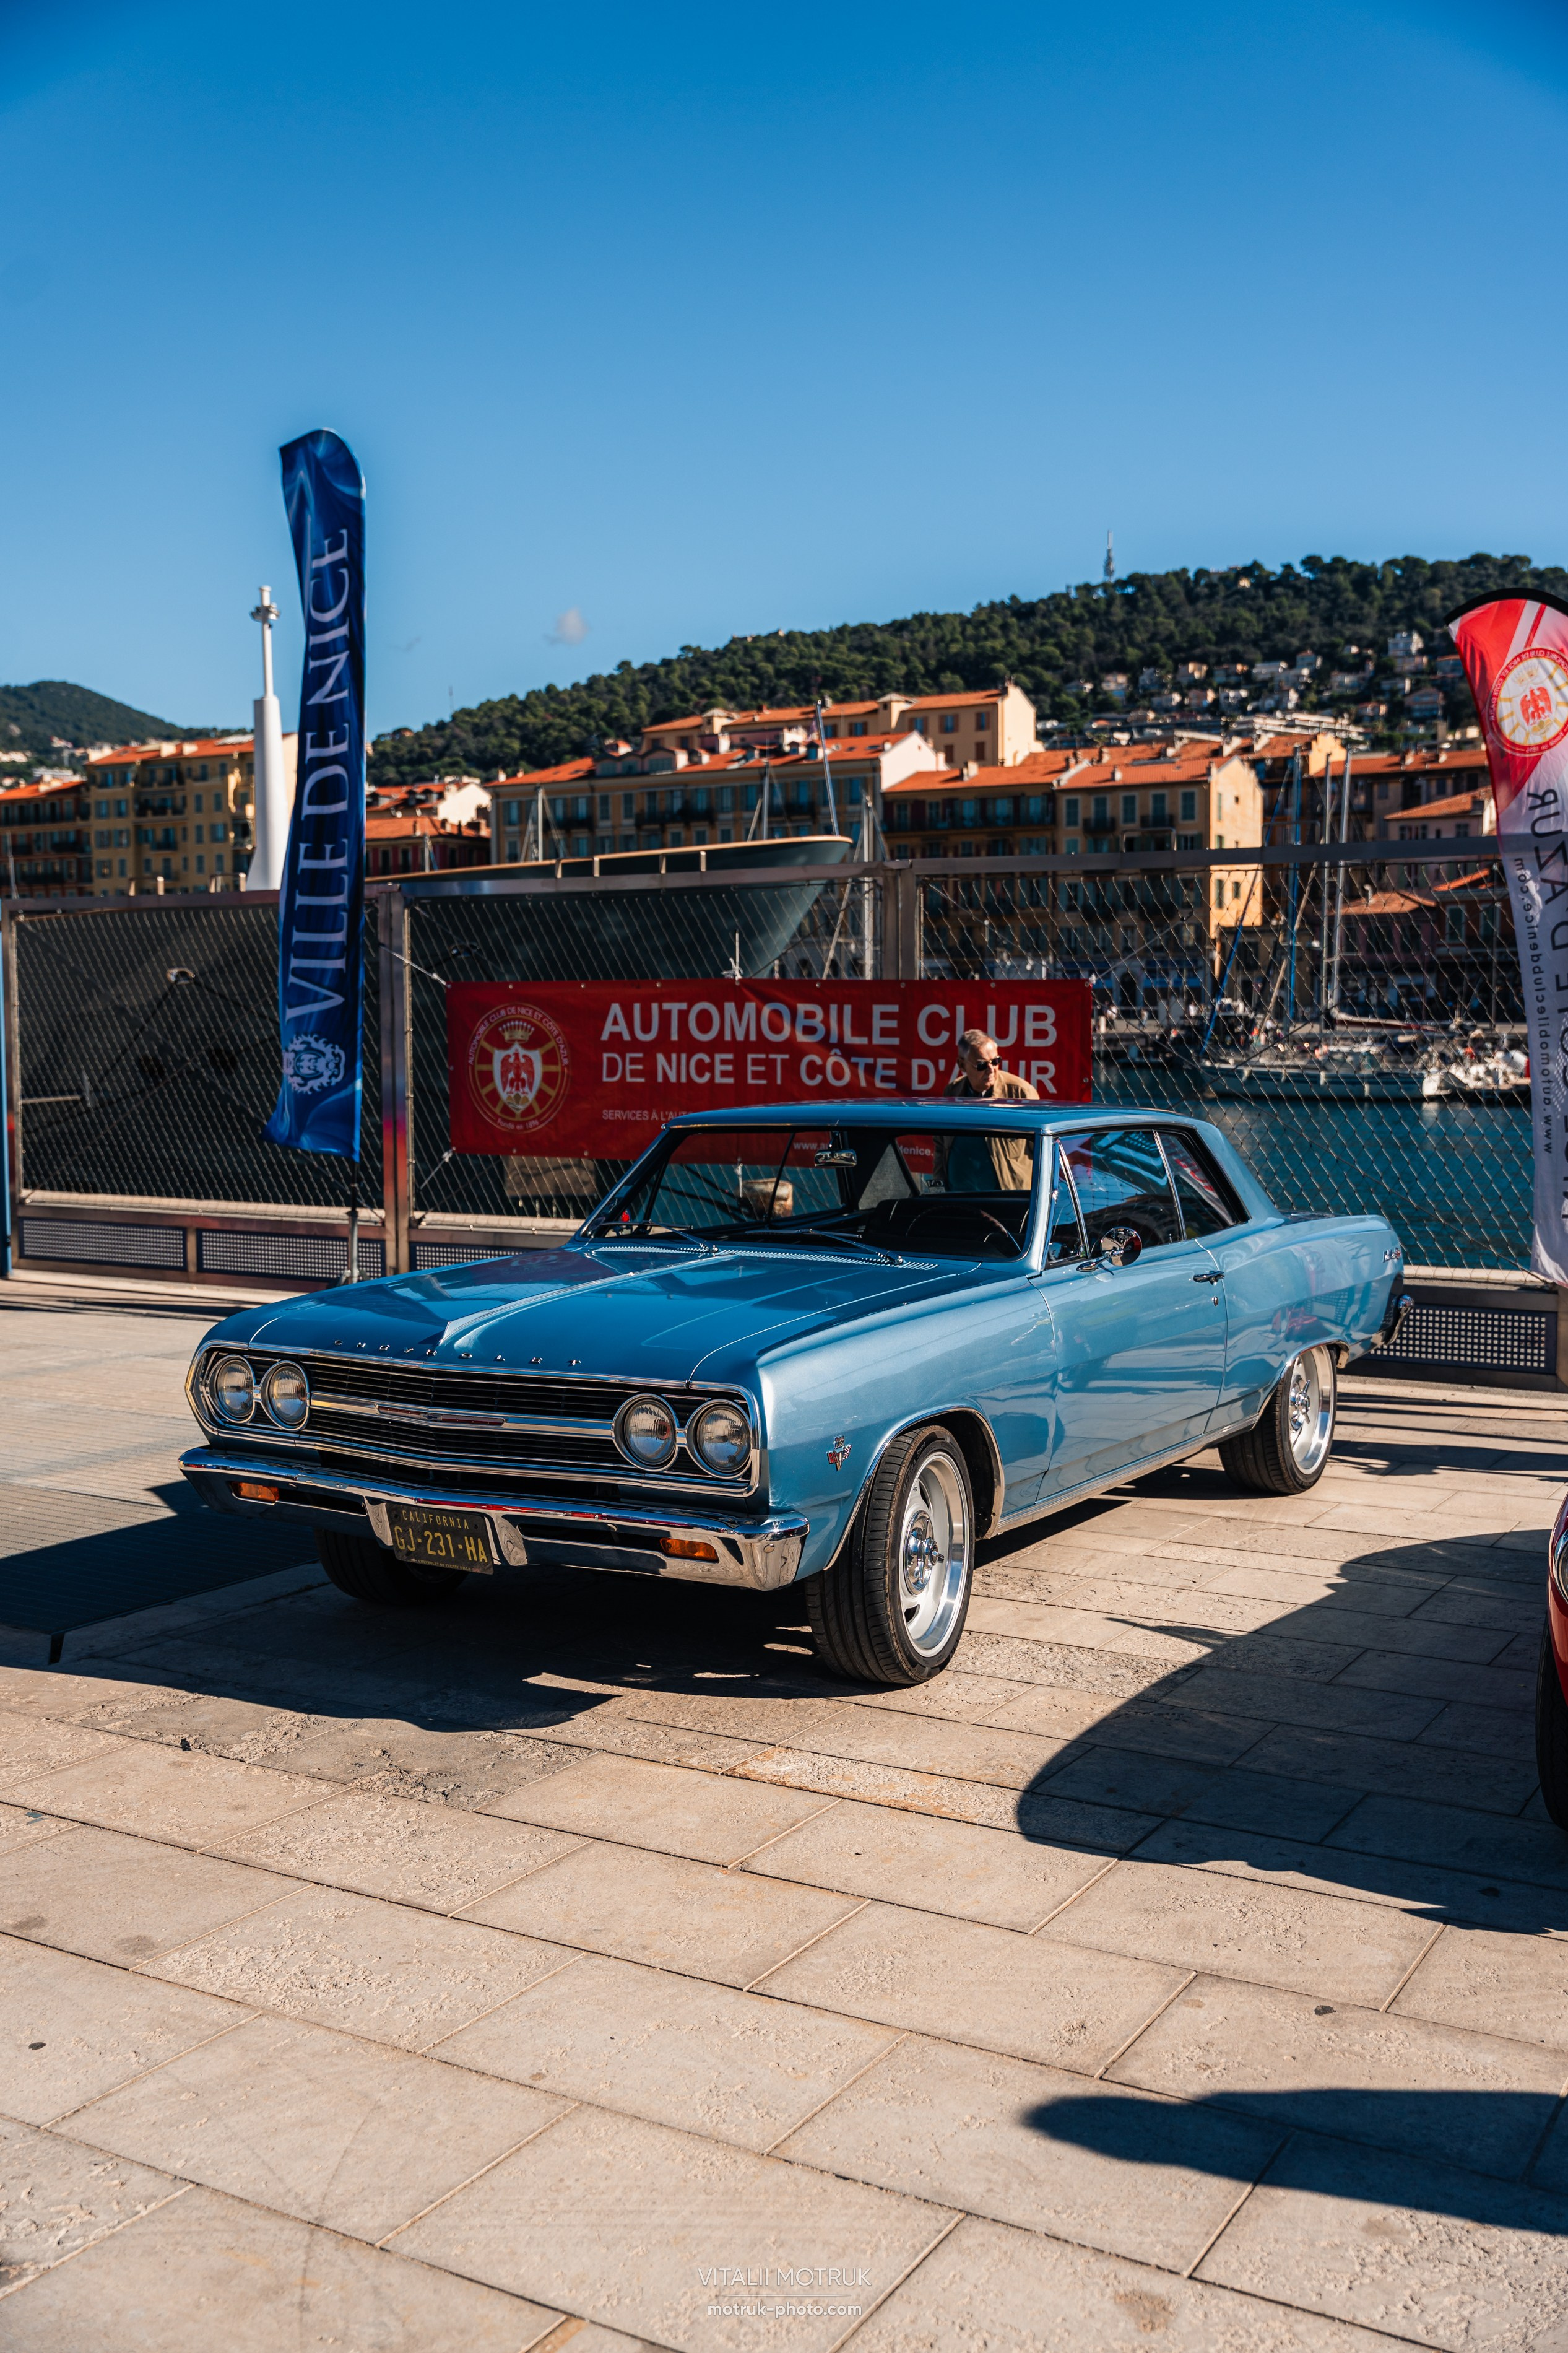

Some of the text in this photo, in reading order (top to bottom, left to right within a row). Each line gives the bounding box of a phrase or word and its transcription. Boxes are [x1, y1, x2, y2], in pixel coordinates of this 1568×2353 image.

[285, 529, 350, 1024] VILLE DE NICE
[468, 1020, 490, 1065] AUTOMOBILE
[488, 1009, 506, 1022] CLUB
[506, 1007, 516, 1015] DE
[517, 1007, 532, 1017] NICE
[533, 1012, 542, 1021] ET
[600, 1001, 900, 1045] AUTOMOBILE
[602, 1053, 645, 1082] DE
[657, 1053, 734, 1084] NICE
[747, 1054, 790, 1085] ET
[799, 1048, 898, 1089] CÔTE
[602, 1109, 649, 1121] SERVICES
[651, 1108, 659, 1121] À
[402, 1510, 469, 1529] CALIFORNIA
